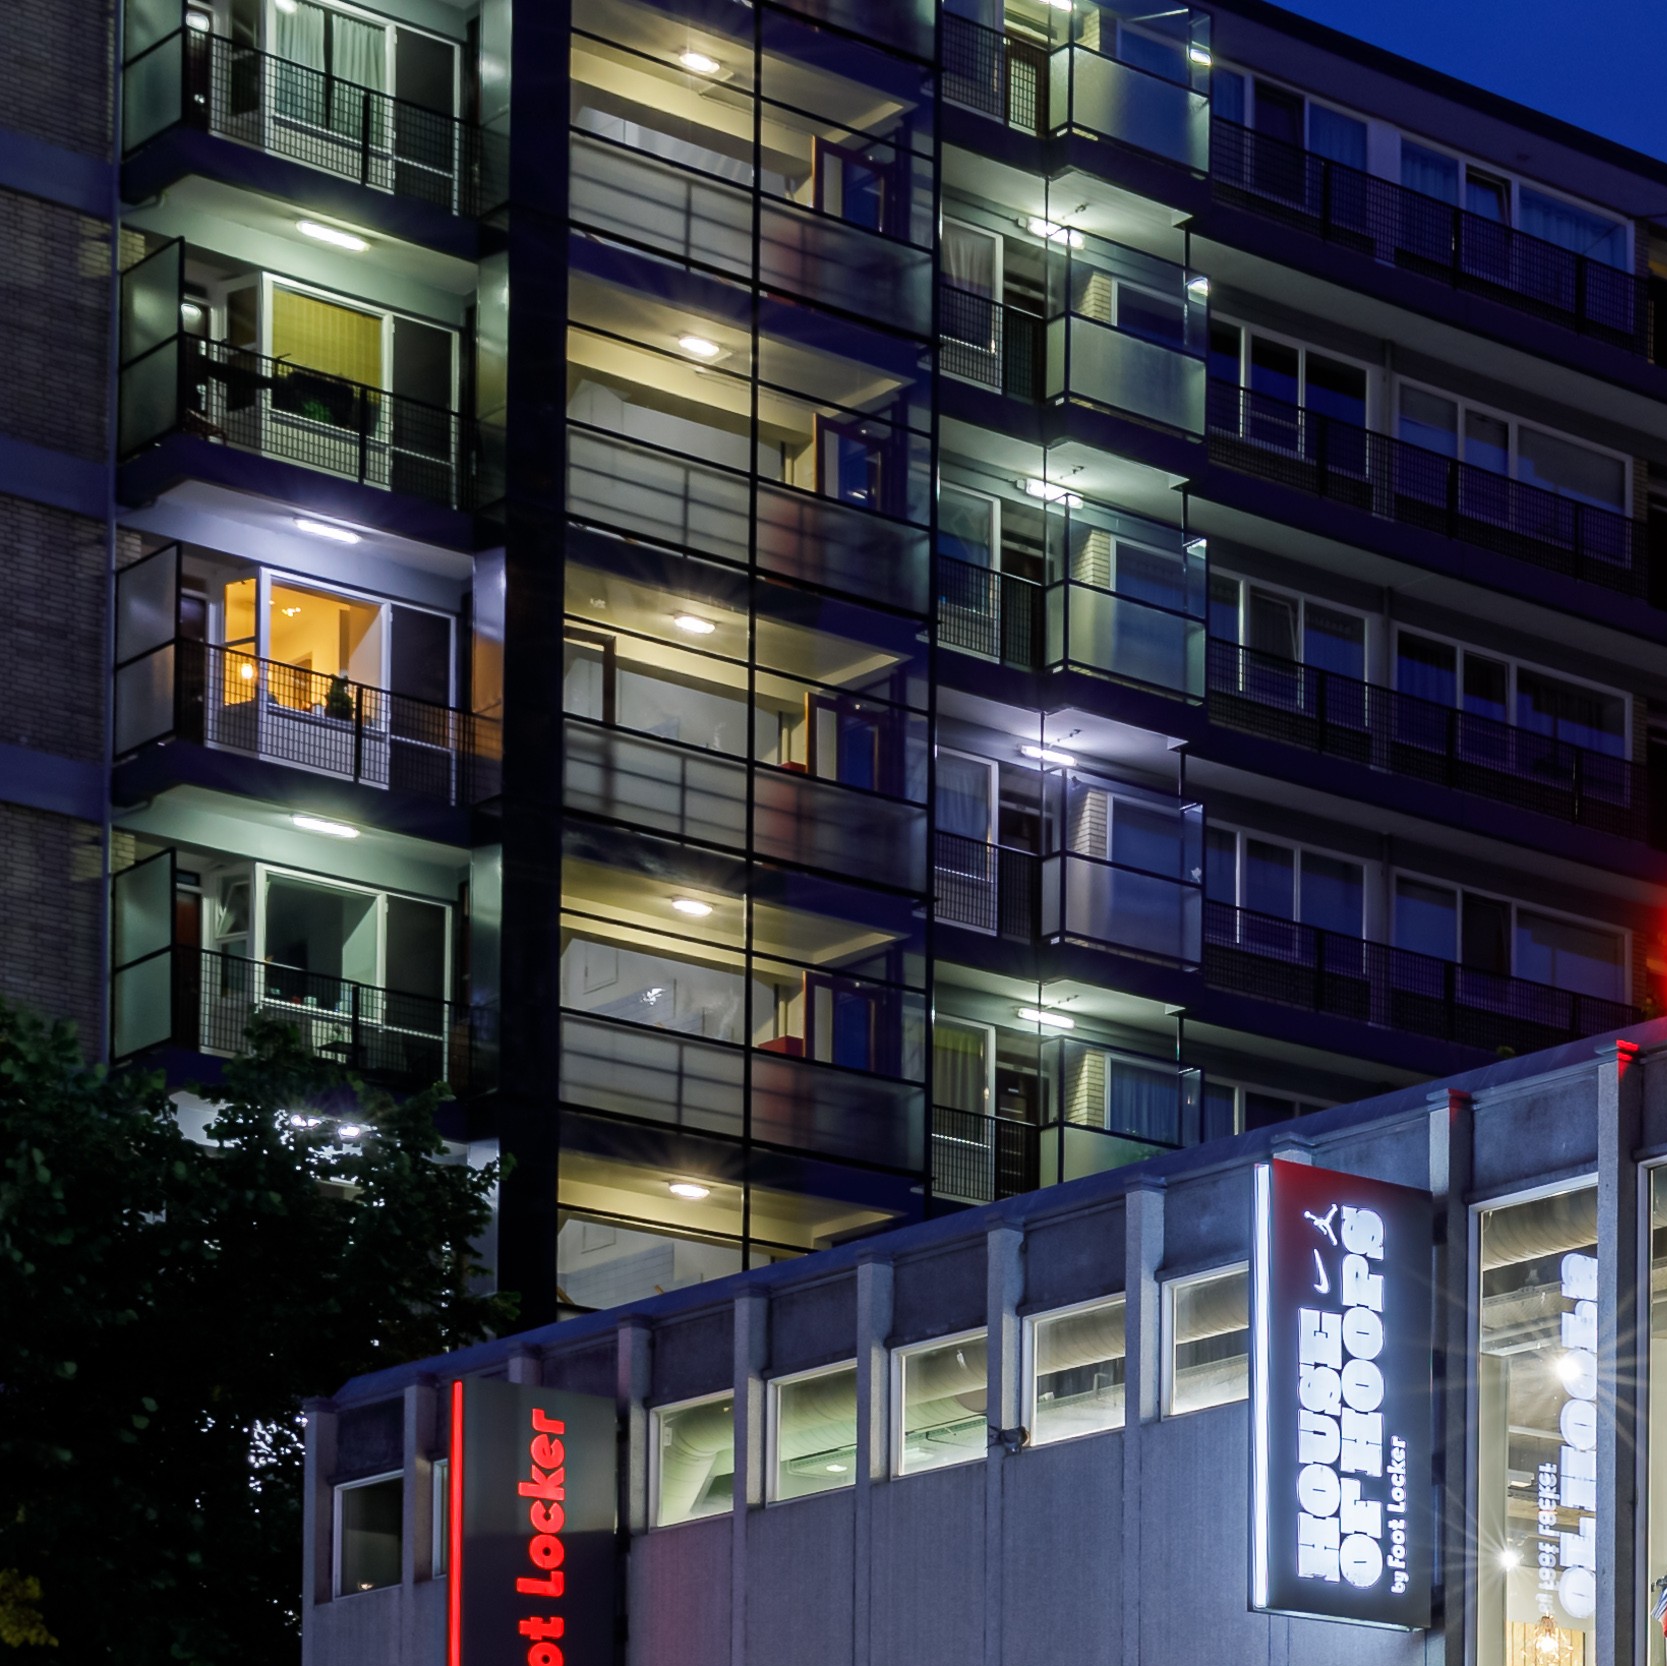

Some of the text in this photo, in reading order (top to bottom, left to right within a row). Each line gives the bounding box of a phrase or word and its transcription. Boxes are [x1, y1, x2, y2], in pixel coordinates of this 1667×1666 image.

[1297, 1306, 1343, 1583] HOUSE
[1340, 1204, 1385, 1589] OF HOOPS
[1386, 1435, 1408, 1513] Locker
[517, 1407, 566, 1597] Locker
[1386, 1518, 1407, 1569] Foot
